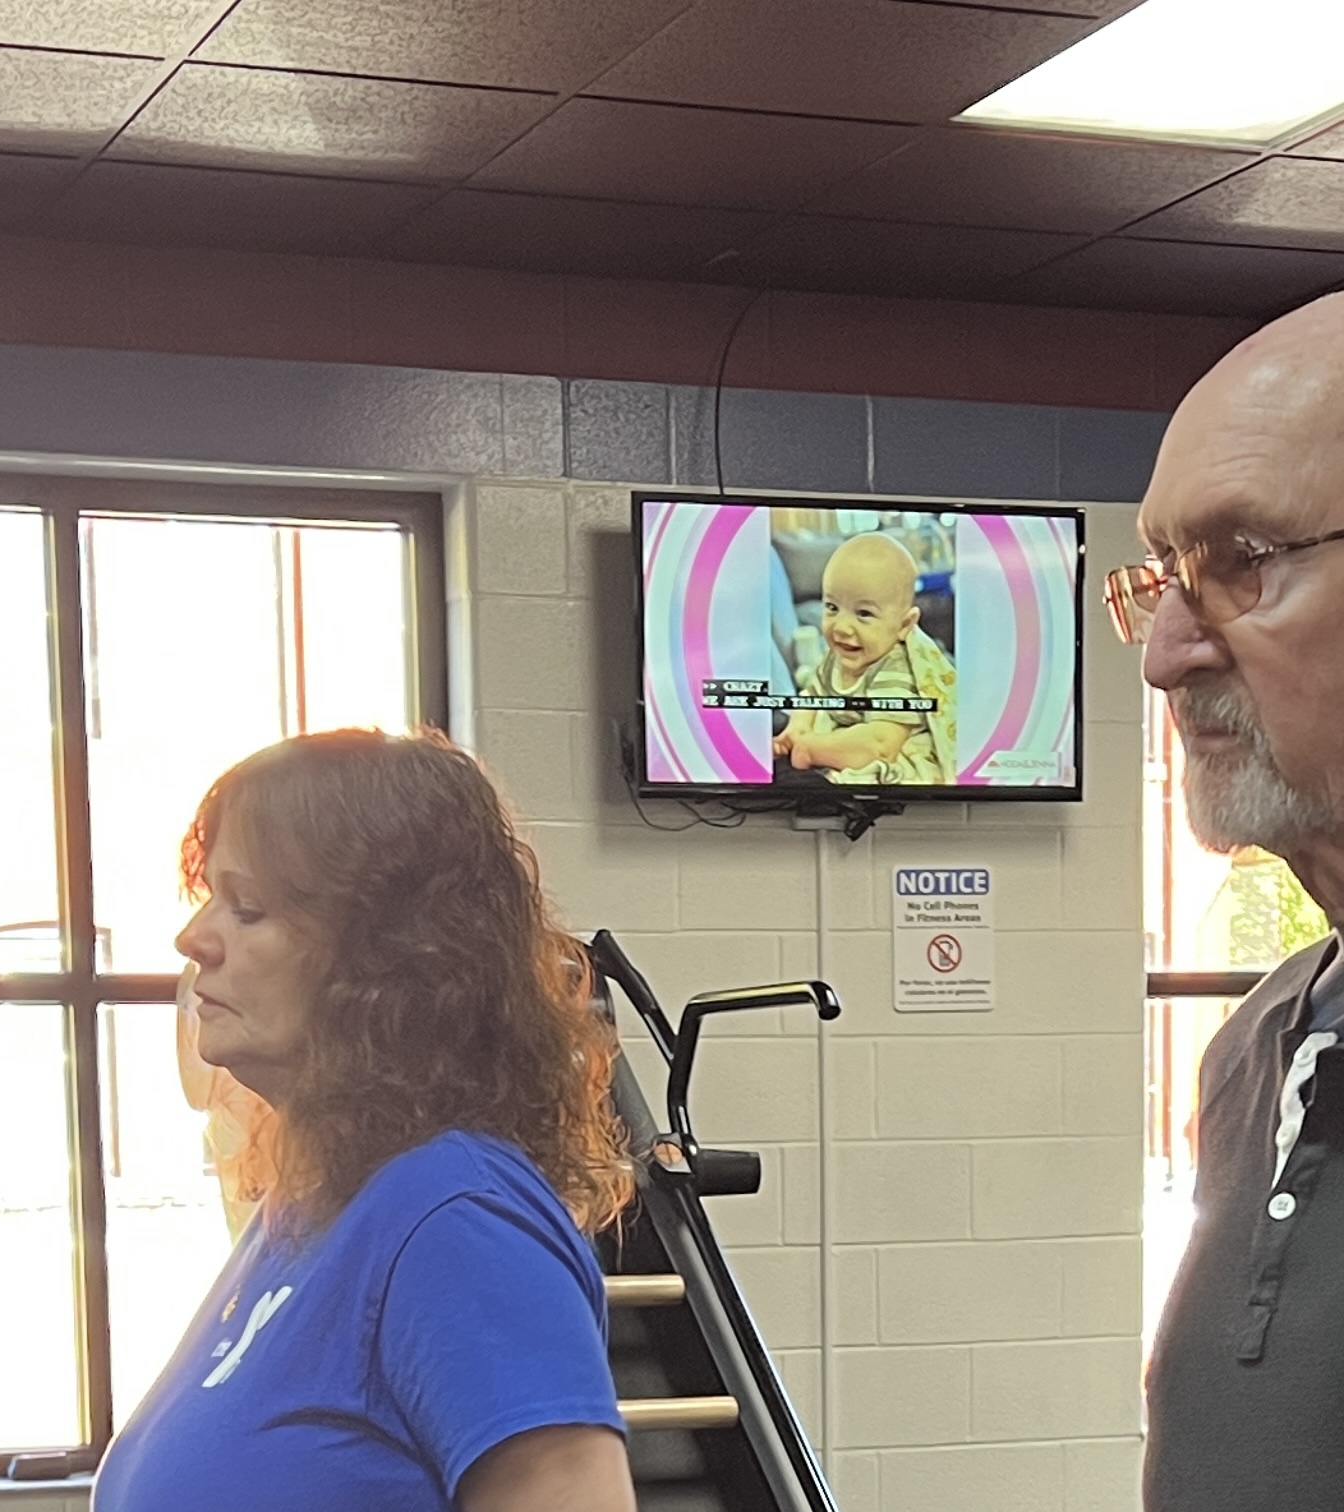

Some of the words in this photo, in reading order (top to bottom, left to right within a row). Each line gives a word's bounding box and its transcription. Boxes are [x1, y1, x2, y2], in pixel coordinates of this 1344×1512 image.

[753, 696, 785, 707] JUST
[791, 697, 846, 708] TALKING
[871, 699, 904, 709] WITH
[908, 699, 933, 709] YOU
[899, 871, 987, 894] NOTICE
[906, 901, 921, 910] No
[923, 901, 941, 911] Cell
[943, 900, 979, 910] Phones
[916, 913, 952, 922] Fitness
[954, 913, 982, 922] Areas
